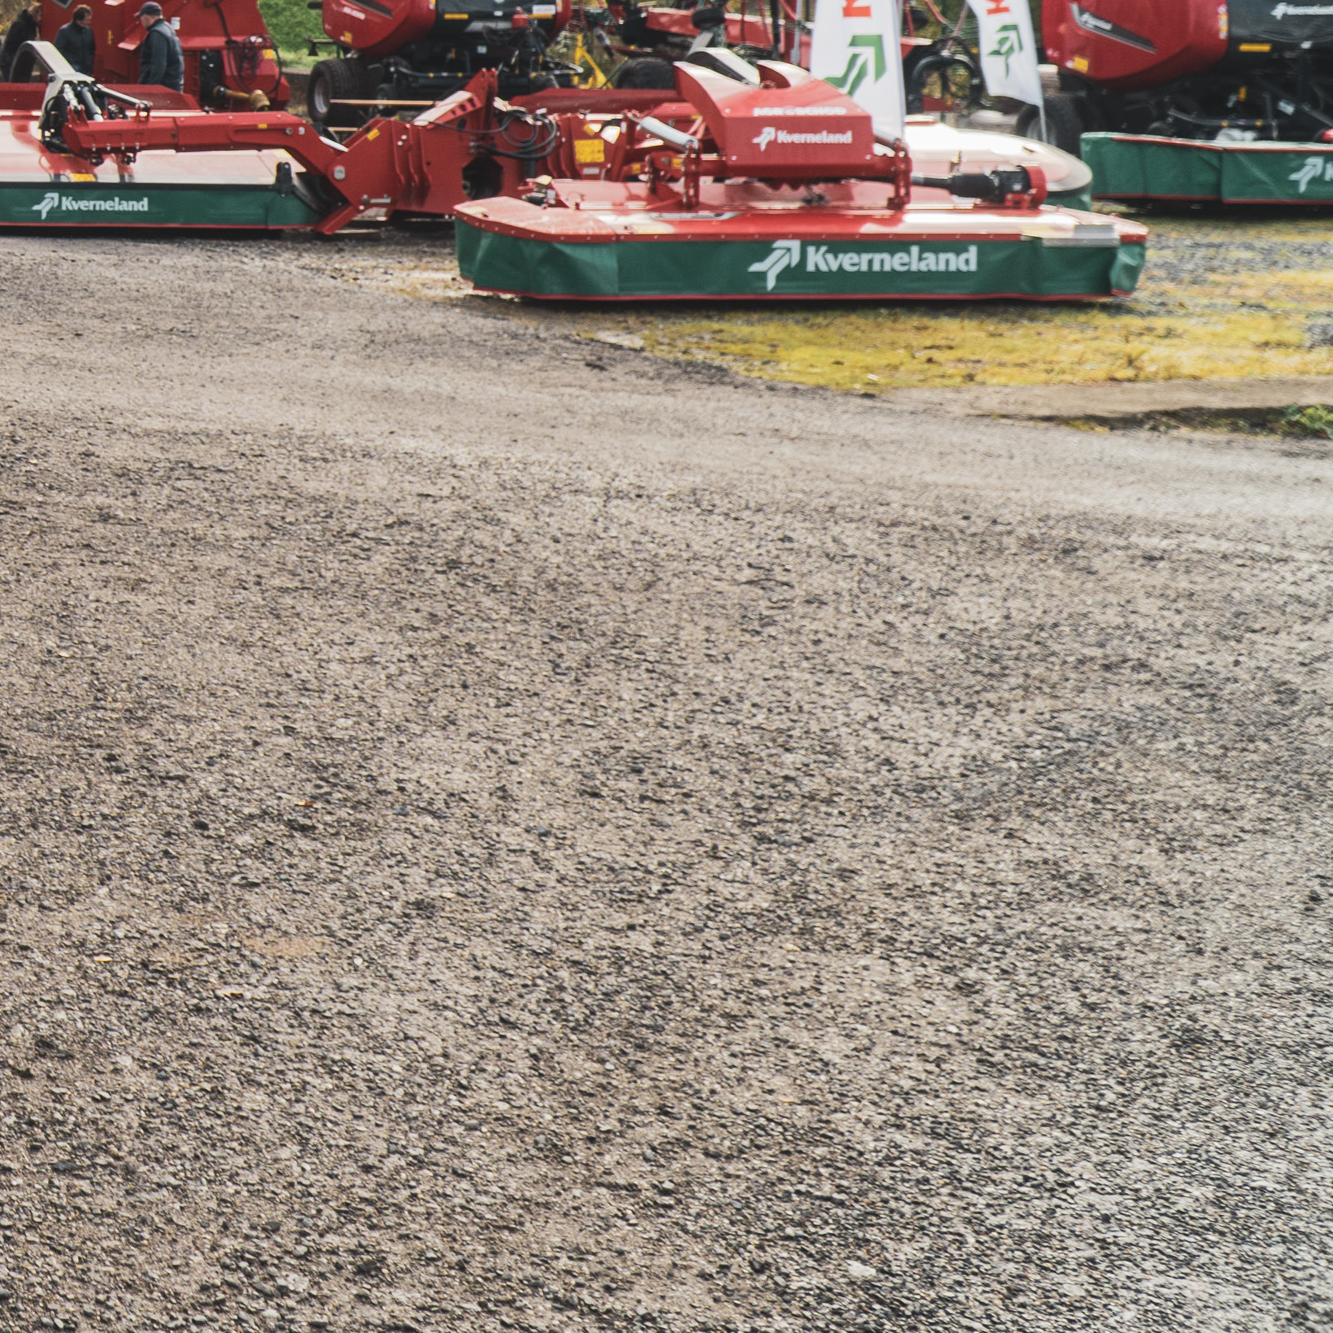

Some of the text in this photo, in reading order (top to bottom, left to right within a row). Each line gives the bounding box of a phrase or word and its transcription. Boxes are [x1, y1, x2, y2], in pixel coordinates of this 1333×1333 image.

[776, 130, 852, 144] Kverneland
[61, 196, 149, 212] Kverneland
[805, 245, 978, 272] Kverneland
